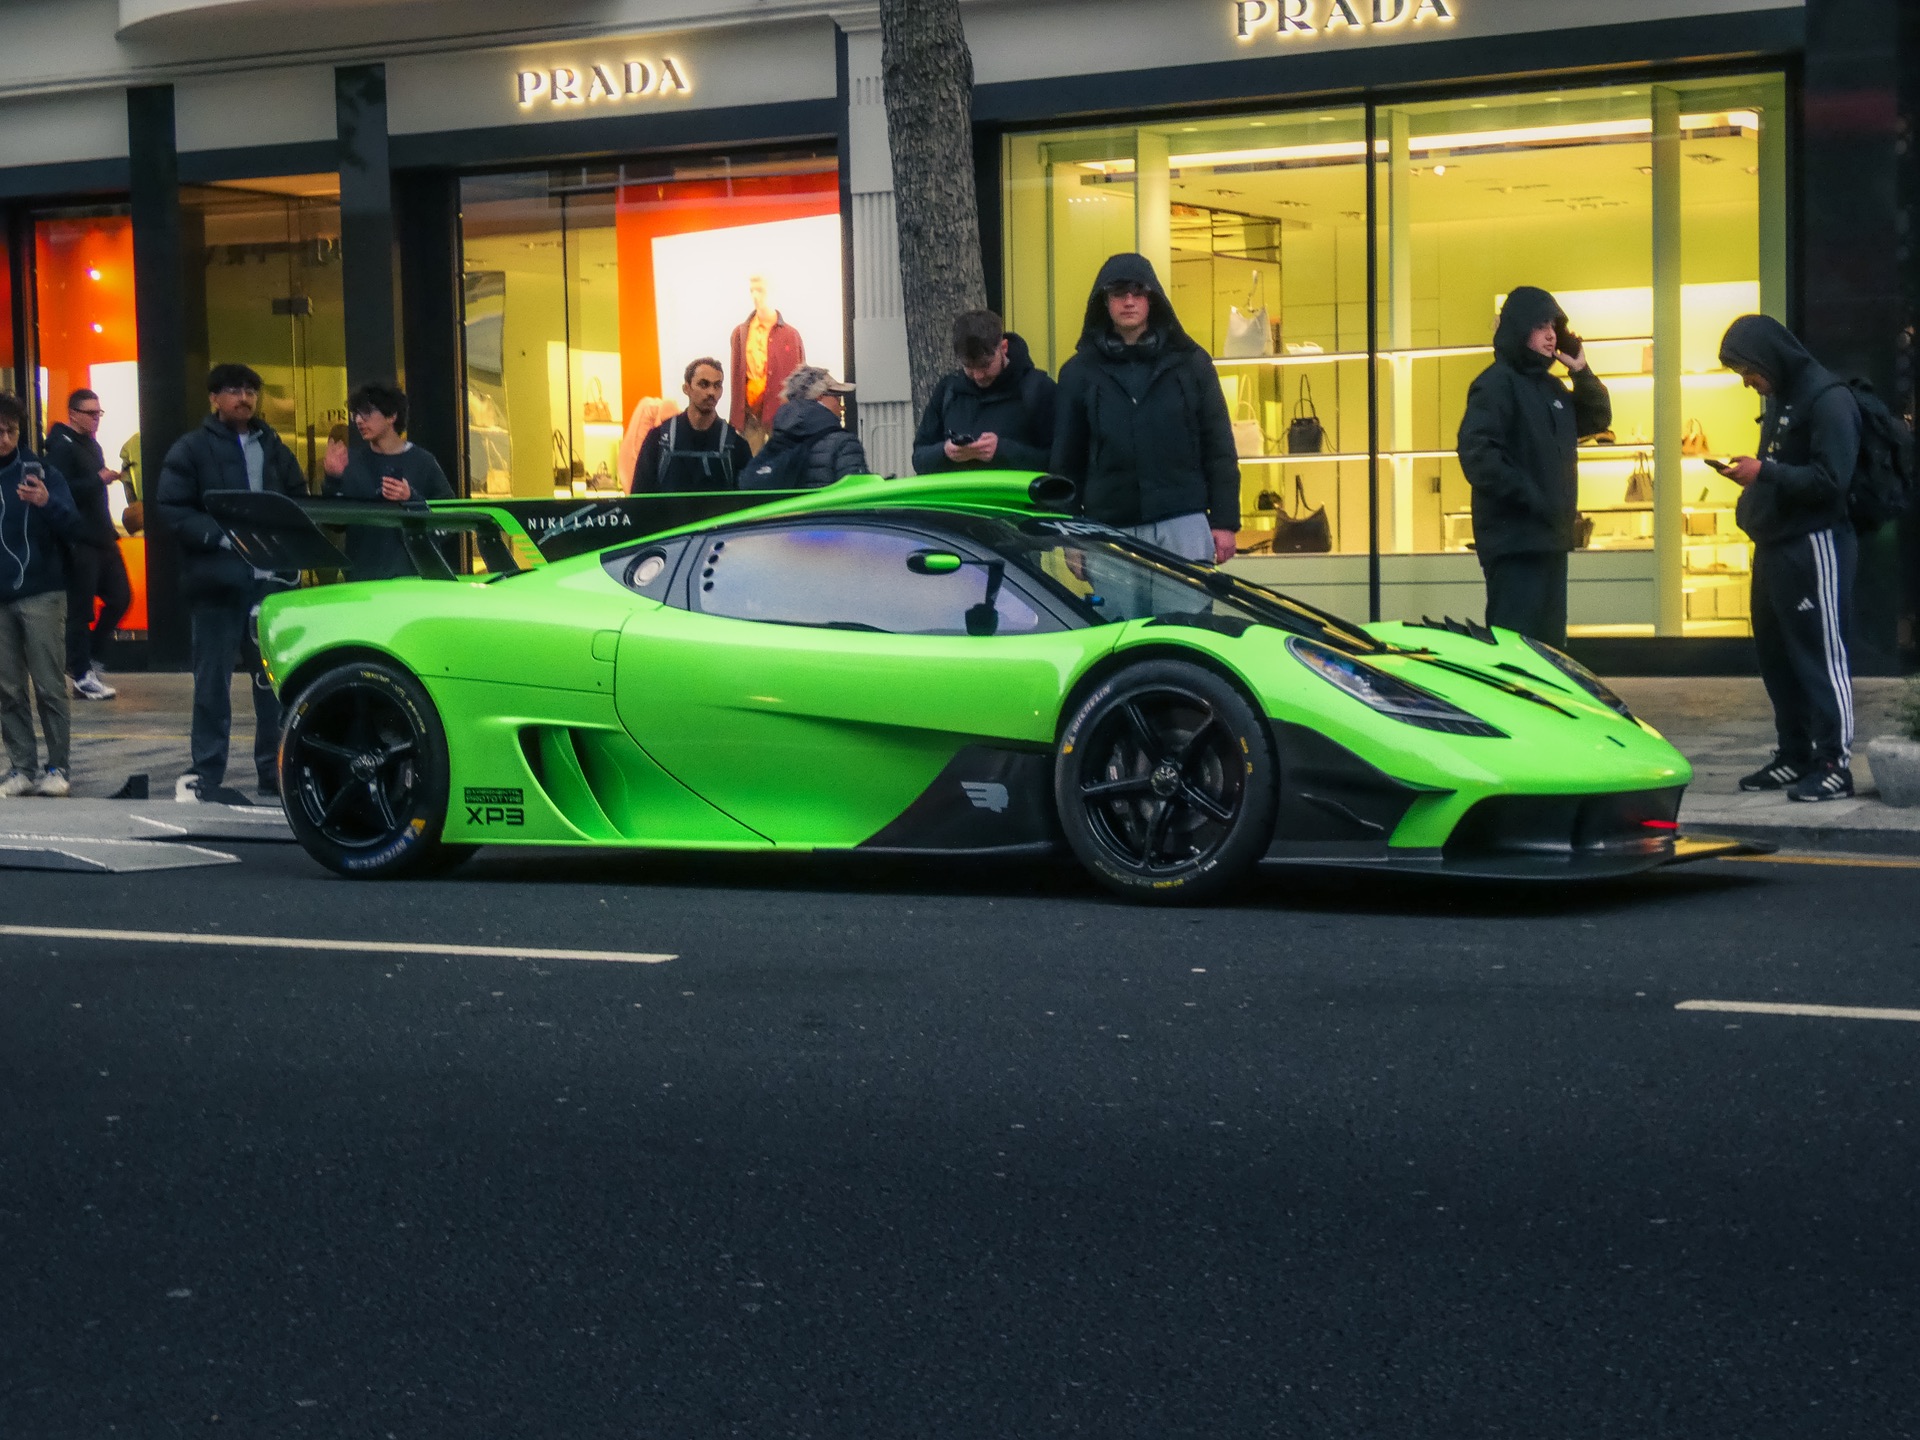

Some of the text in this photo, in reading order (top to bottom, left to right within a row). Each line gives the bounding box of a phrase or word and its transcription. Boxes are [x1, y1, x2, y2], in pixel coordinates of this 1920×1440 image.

[1236, 0, 1453, 37] PRADA
[516, 57, 688, 105] PRADA
[528, 513, 632, 530] NIKI LAUDA
[1072, 684, 1111, 733] MICHELIN
[466, 806, 525, 826] XP3
[348, 838, 408, 870] MICHELIN
